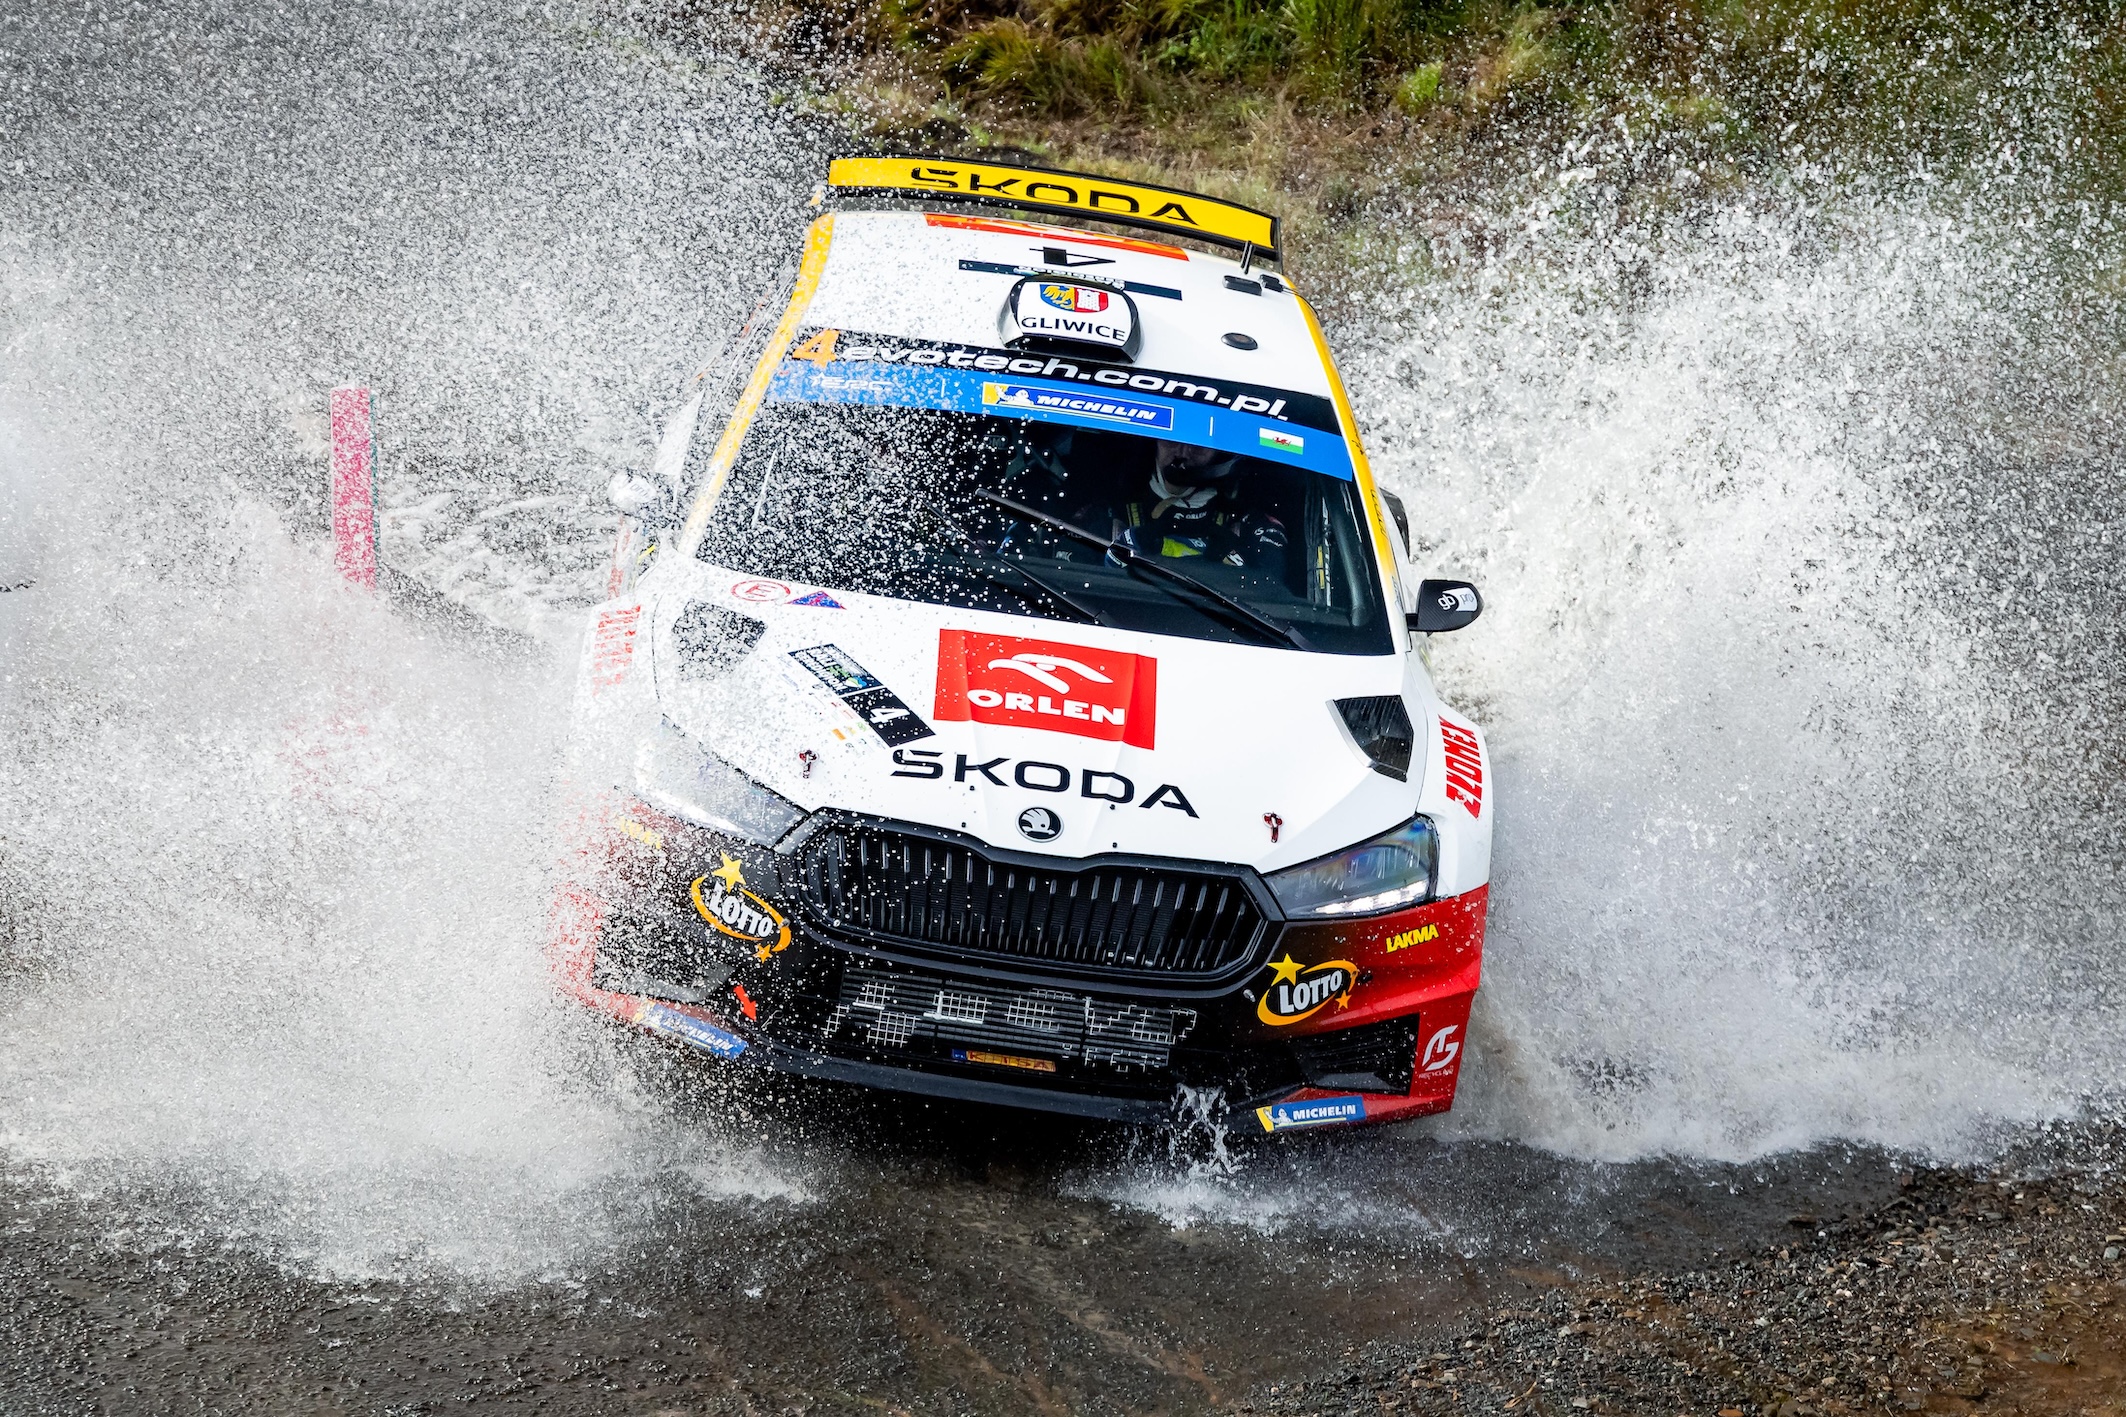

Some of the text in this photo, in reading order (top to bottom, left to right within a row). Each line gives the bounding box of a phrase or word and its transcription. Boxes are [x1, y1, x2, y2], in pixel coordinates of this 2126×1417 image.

[1021, 317, 1126, 341] GLIWICE
[792, 328, 840, 368] 4
[1036, 395, 1157, 421] MICHELIN
[869, 707, 911, 724] 4
[967, 689, 1126, 726] ORLEN
[708, 881, 774, 938] LOTTO
[1386, 924, 1439, 953] LAKMA
[1279, 970, 1343, 1014] LOTTO
[1292, 1105, 1357, 1120] MICHELIN
